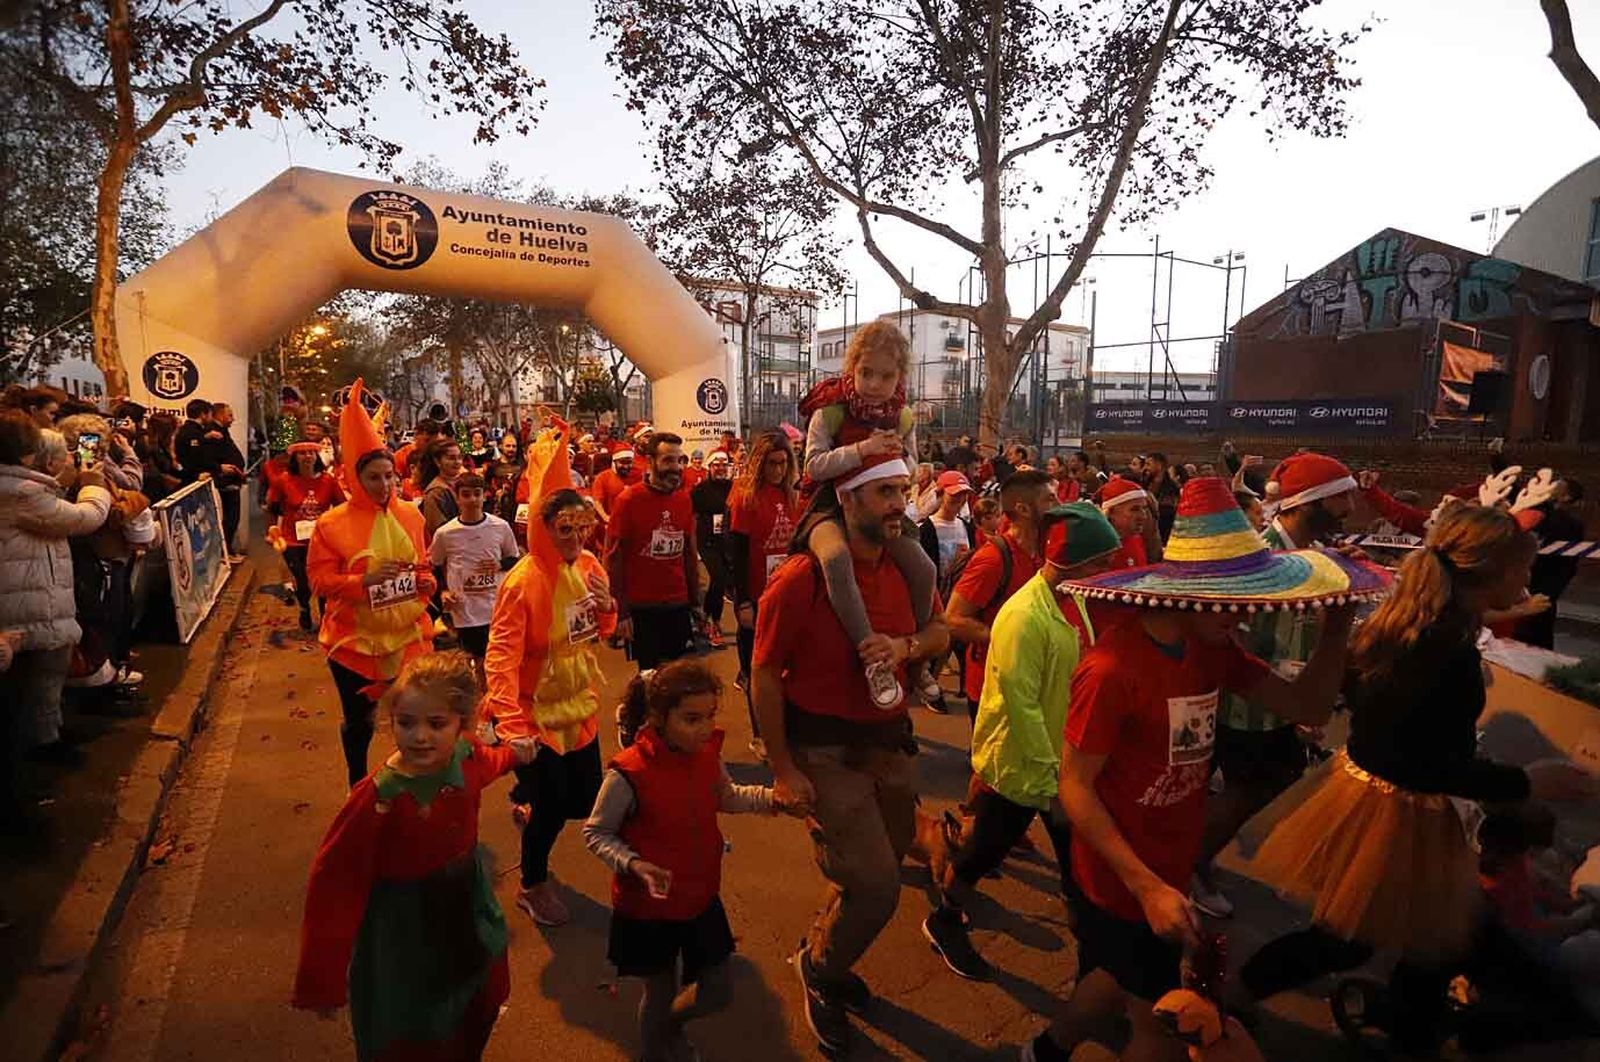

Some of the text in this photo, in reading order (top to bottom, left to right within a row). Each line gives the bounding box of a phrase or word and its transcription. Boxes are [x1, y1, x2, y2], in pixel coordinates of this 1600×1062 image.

[442, 205, 587, 237] Ayuntamiento
[487, 228, 588, 253] de Huelva
[520, 252, 535, 262] de
[537, 252, 591, 268] Deportes
[1108, 410, 1143, 418] HYUNDAI
[1168, 409, 1209, 417] HYUNDAI
[1248, 408, 1297, 417] HYUNDAI
[1331, 407, 1389, 418] HYUNDAI
[390, 577, 413, 595] 142
